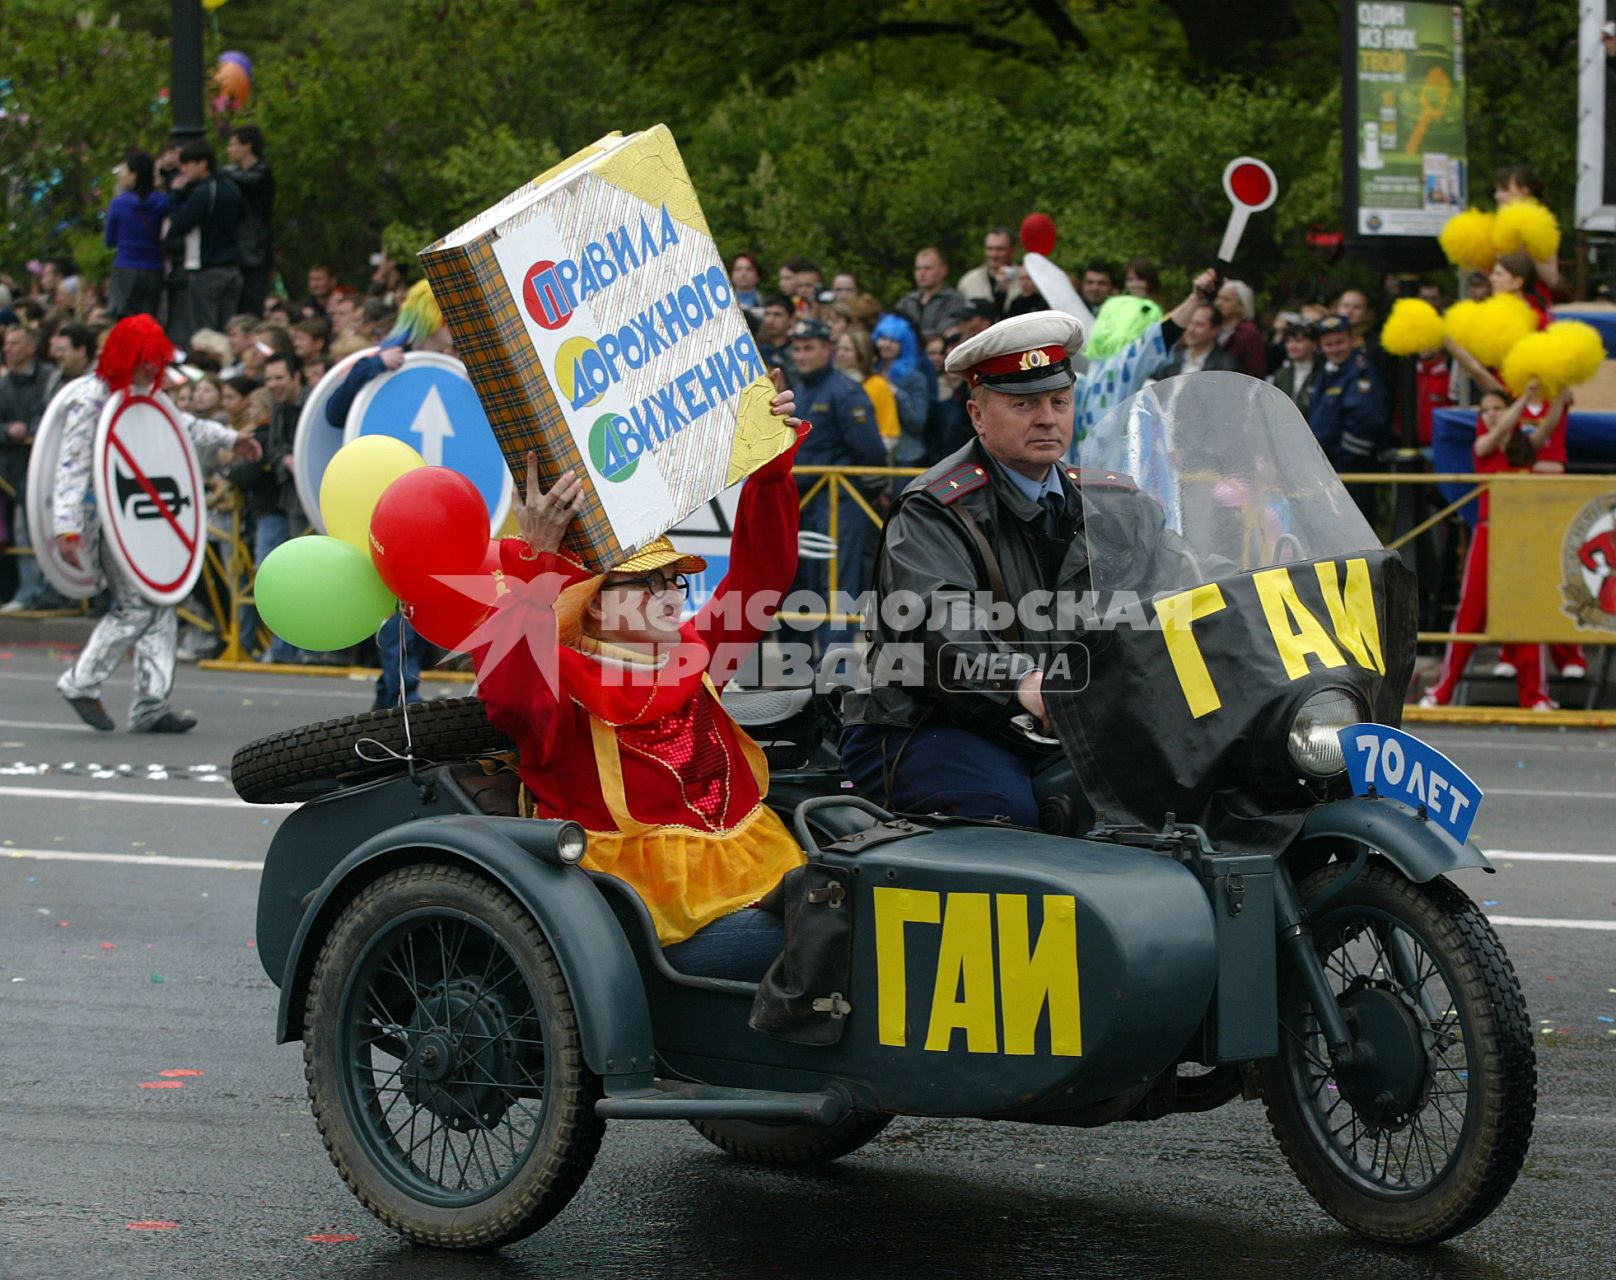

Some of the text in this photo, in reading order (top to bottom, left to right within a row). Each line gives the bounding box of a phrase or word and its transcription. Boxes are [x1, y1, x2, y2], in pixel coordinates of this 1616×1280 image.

[1358, 3, 1405, 28] ОДИН
[1358, 28, 1418, 50] ИЗ НИХ
[532, 201, 679, 323] ПРАВИЛА
[570, 265, 731, 412] ДОРОЖНОГО
[601, 331, 765, 478] ДВИЖЕНИЯ
[1153, 558, 1386, 719] ГАИ
[1355, 734, 1470, 825] 70 ЛЕТ
[873, 886, 1083, 1057] ГАИ
